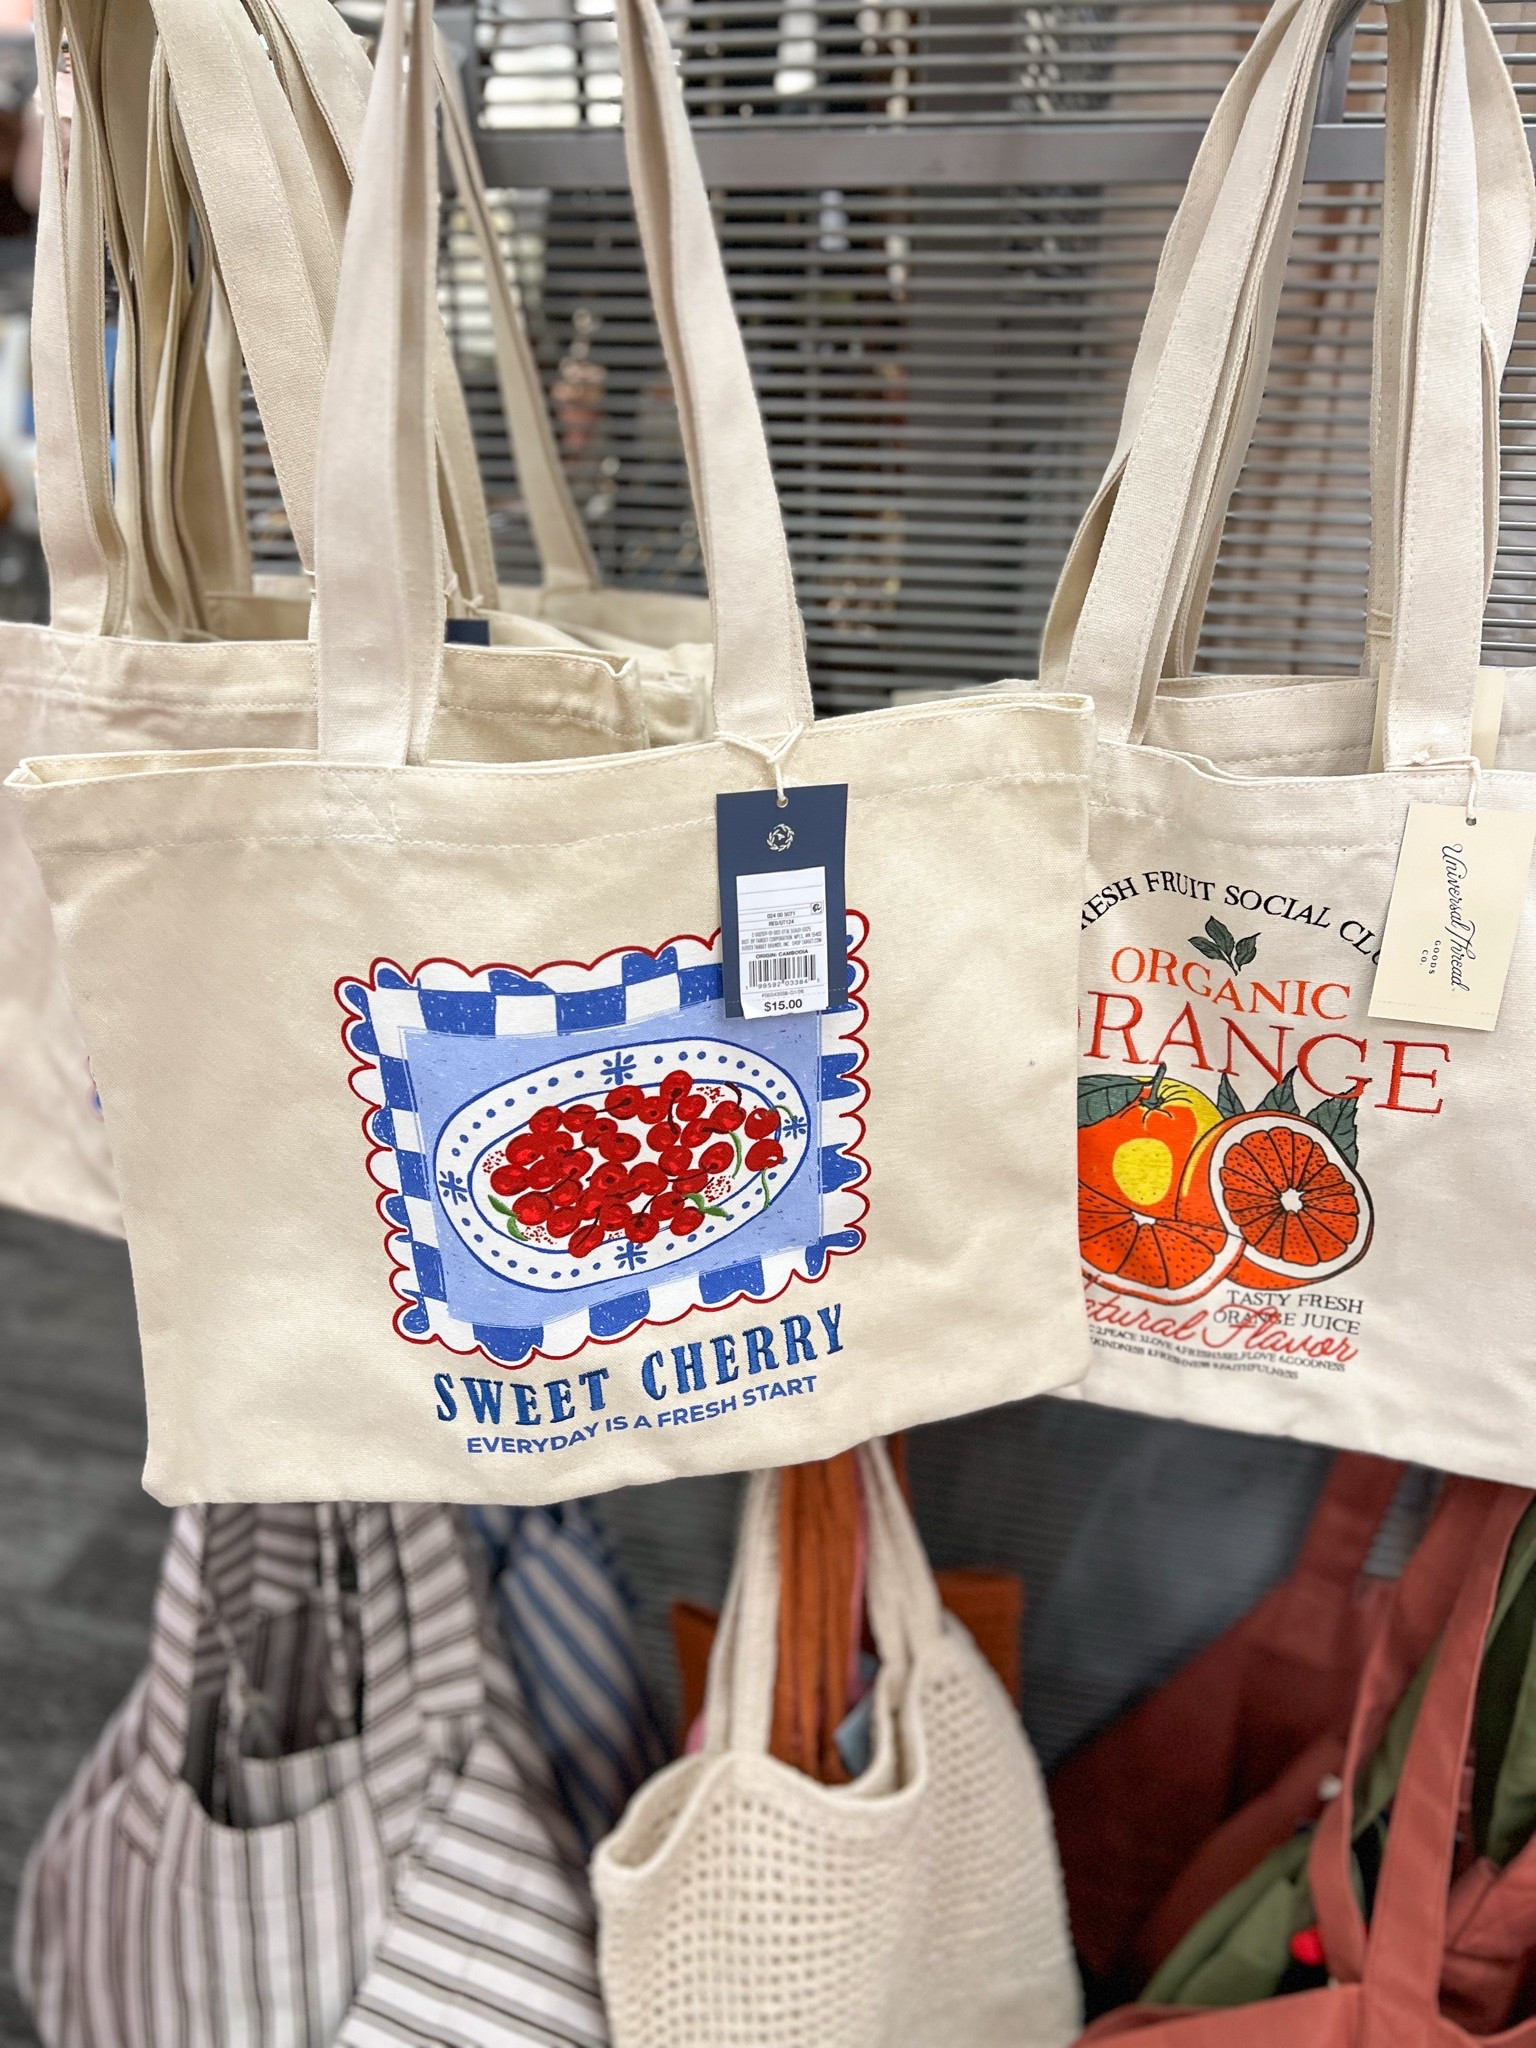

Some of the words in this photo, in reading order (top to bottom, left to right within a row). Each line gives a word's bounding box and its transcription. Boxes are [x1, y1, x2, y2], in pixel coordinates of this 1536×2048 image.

[1142, 871, 1216, 901] FRUIT
[1224, 885, 1331, 928] SOCIAL
[1441, 843, 1472, 932] Universal
[778, 949, 808, 957] CAMBODIA
[1111, 946, 1350, 1020] ORGANIC
[1420, 949, 1428, 966] CO.
[1428, 940, 1441, 975] GOODS
[1444, 920, 1476, 992] Thread
[764, 999, 803, 1012] $15.00
[1077, 990, 1451, 1114] RANGE
[1084, 1288, 1208, 1341] tural
[1202, 1303, 1359, 1362] Flavor
[1227, 1290, 1291, 1306] TASTY
[1298, 1294, 1364, 1314] FRESH
[1301, 1313, 1361, 1335] JUICE
[433, 1367, 609, 1426] SWEET
[641, 1303, 844, 1401] CHERRY
[467, 1421, 600, 1454] EVERYDAY
[606, 1416, 629, 1432] IS
[633, 1415, 653, 1430] A
[658, 1396, 737, 1429] FRESH
[743, 1375, 818, 1406] START
